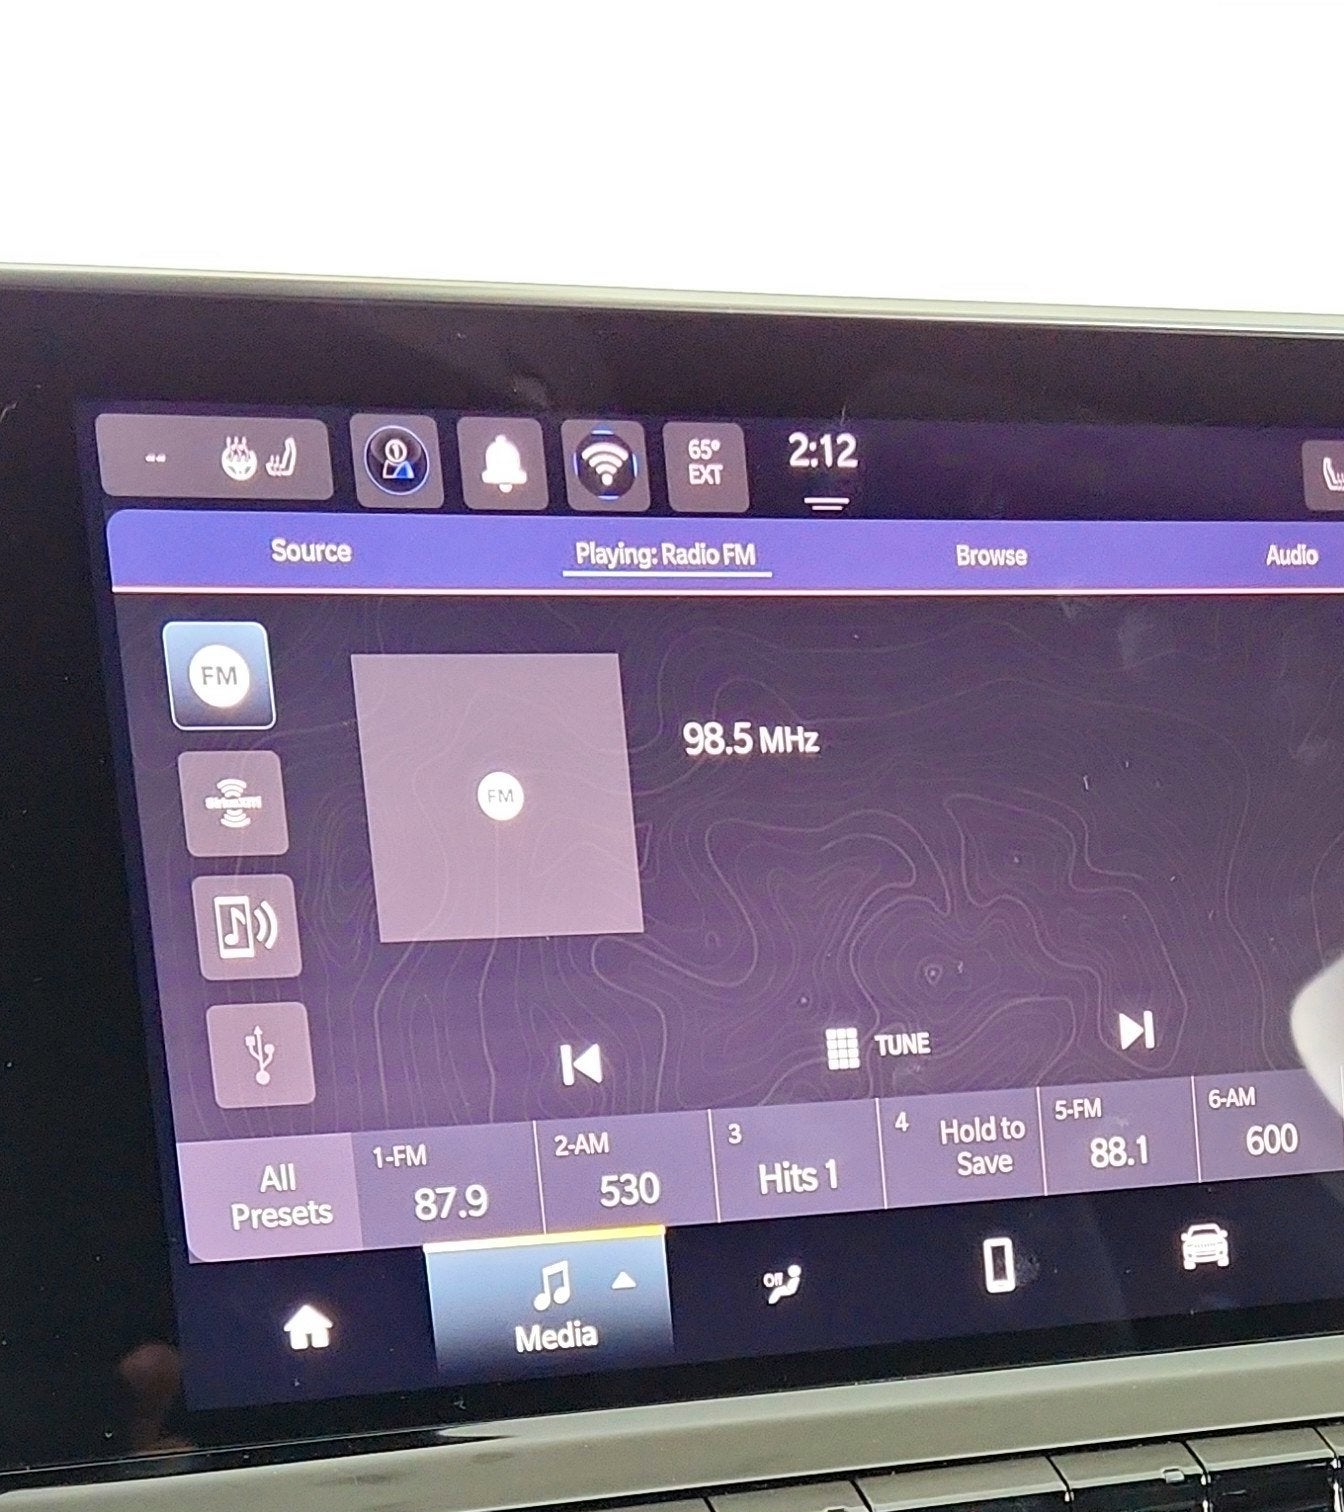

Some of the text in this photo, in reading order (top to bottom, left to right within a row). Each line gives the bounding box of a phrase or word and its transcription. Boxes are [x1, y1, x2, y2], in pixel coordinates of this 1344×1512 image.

[788, 432, 858, 469] 2:12
[688, 463, 723, 485] EXT
[271, 537, 352, 564] Source
[576, 541, 755, 569] Playing: Radio FM
[956, 544, 1028, 567] Browse
[1266, 543, 1319, 567] Audio
[201, 665, 238, 687] FM
[683, 721, 821, 756] 98.5 MHz
[487, 788, 515, 805] FM
[874, 1032, 931, 1057] TUNE
[1054, 1097, 1102, 1121] 5-FM
[1208, 1086, 1256, 1110] 6-AM
[728, 1124, 742, 1144] 3
[894, 1112, 909, 1133] 4
[940, 1116, 1026, 1145] Hold to
[554, 1131, 610, 1157] 2-AM
[1089, 1135, 1149, 1168] 88.1
[1246, 1123, 1298, 1156] 600
[373, 1144, 427, 1168] 1-FM
[957, 1150, 1013, 1176] Save
[259, 1164, 297, 1191] All
[599, 1173, 659, 1207] 530
[758, 1159, 839, 1196] Hits 1
[414, 1184, 488, 1221] 87.9
[231, 1201, 334, 1231] Presets
[514, 1321, 598, 1353] Media
